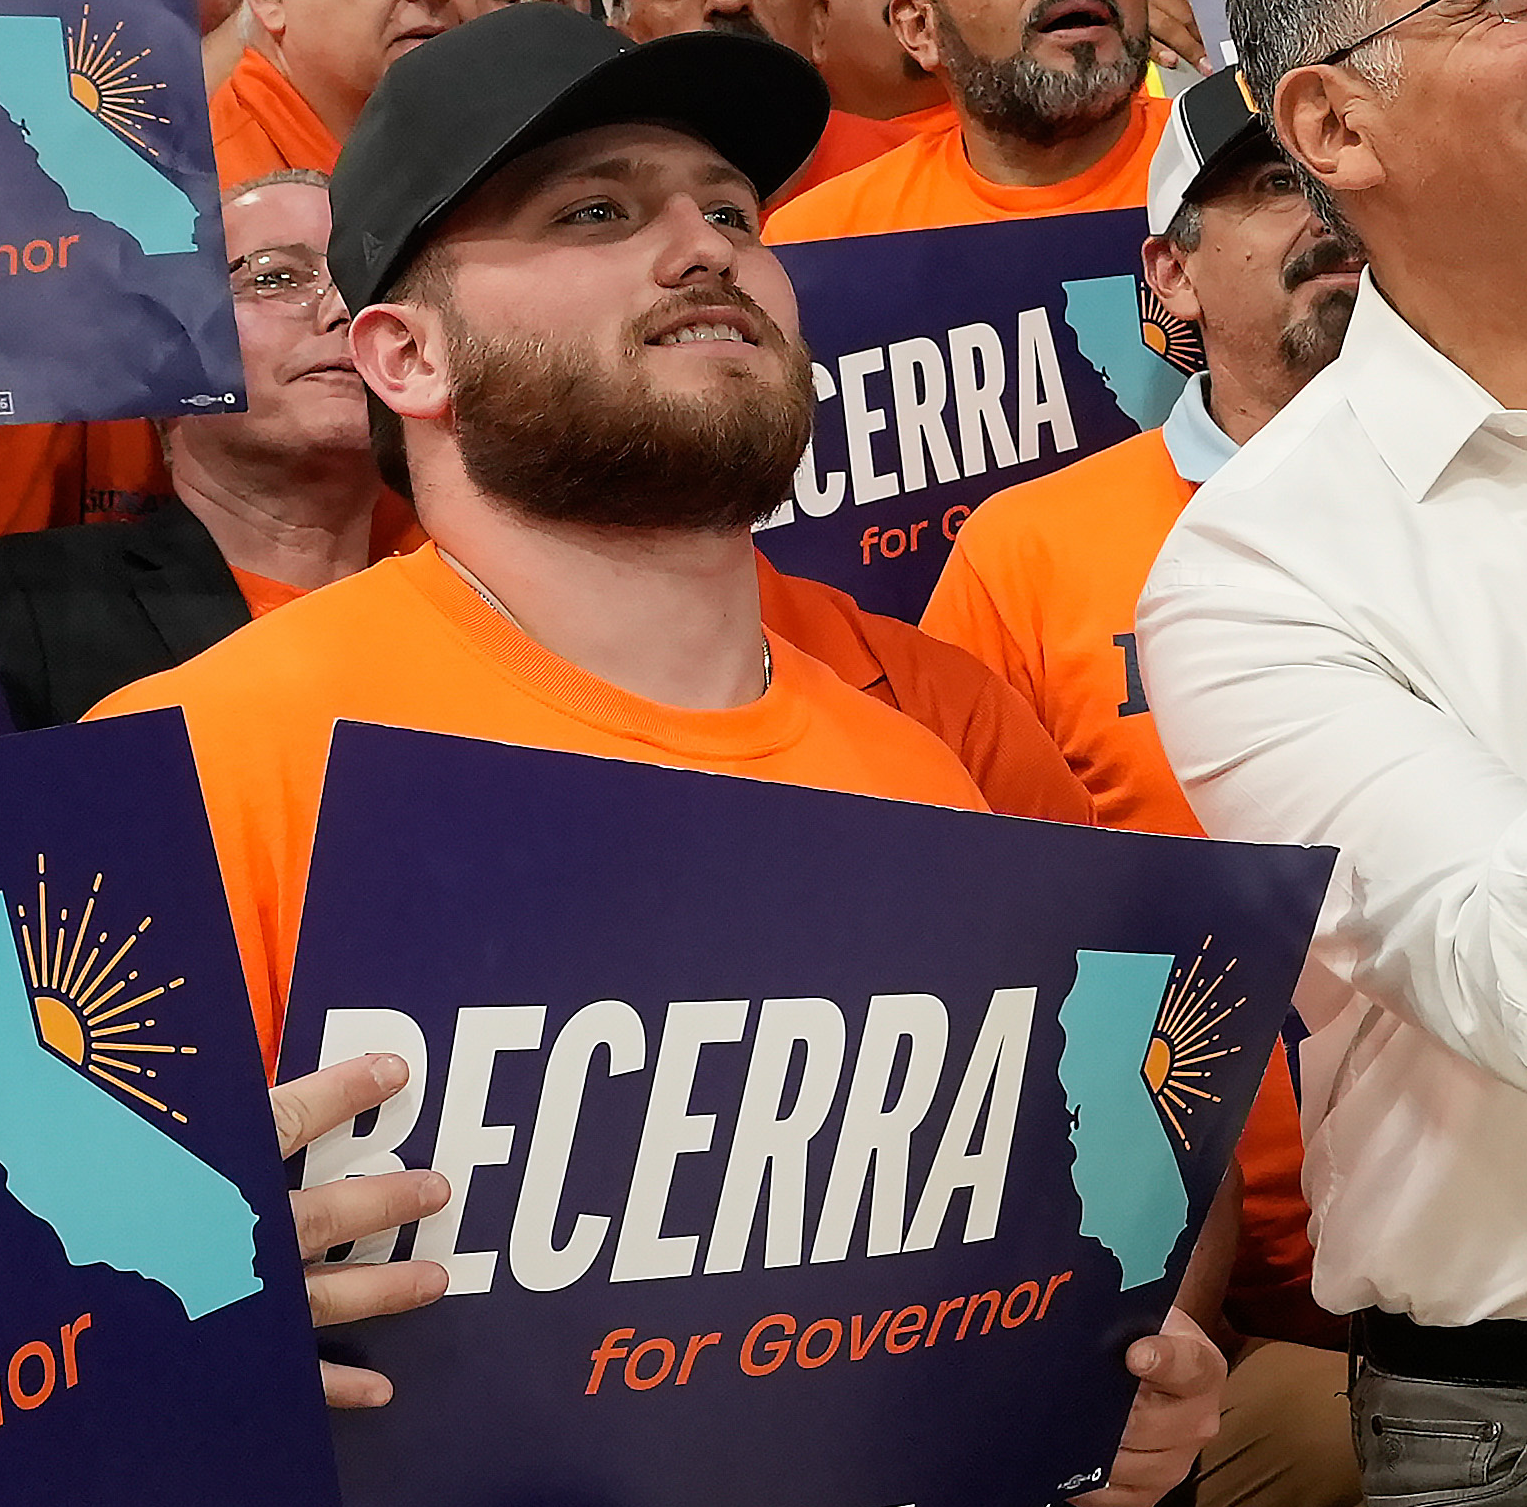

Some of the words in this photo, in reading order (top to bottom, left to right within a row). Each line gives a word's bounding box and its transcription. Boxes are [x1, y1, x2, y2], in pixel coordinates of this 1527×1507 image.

[751, 307, 1078, 533] CERRA
[861, 521, 928, 564] for
[301, 987, 1037, 1295] BECERRA
[585, 1328, 721, 1394] for
[741, 1271, 1072, 1376] Governor
